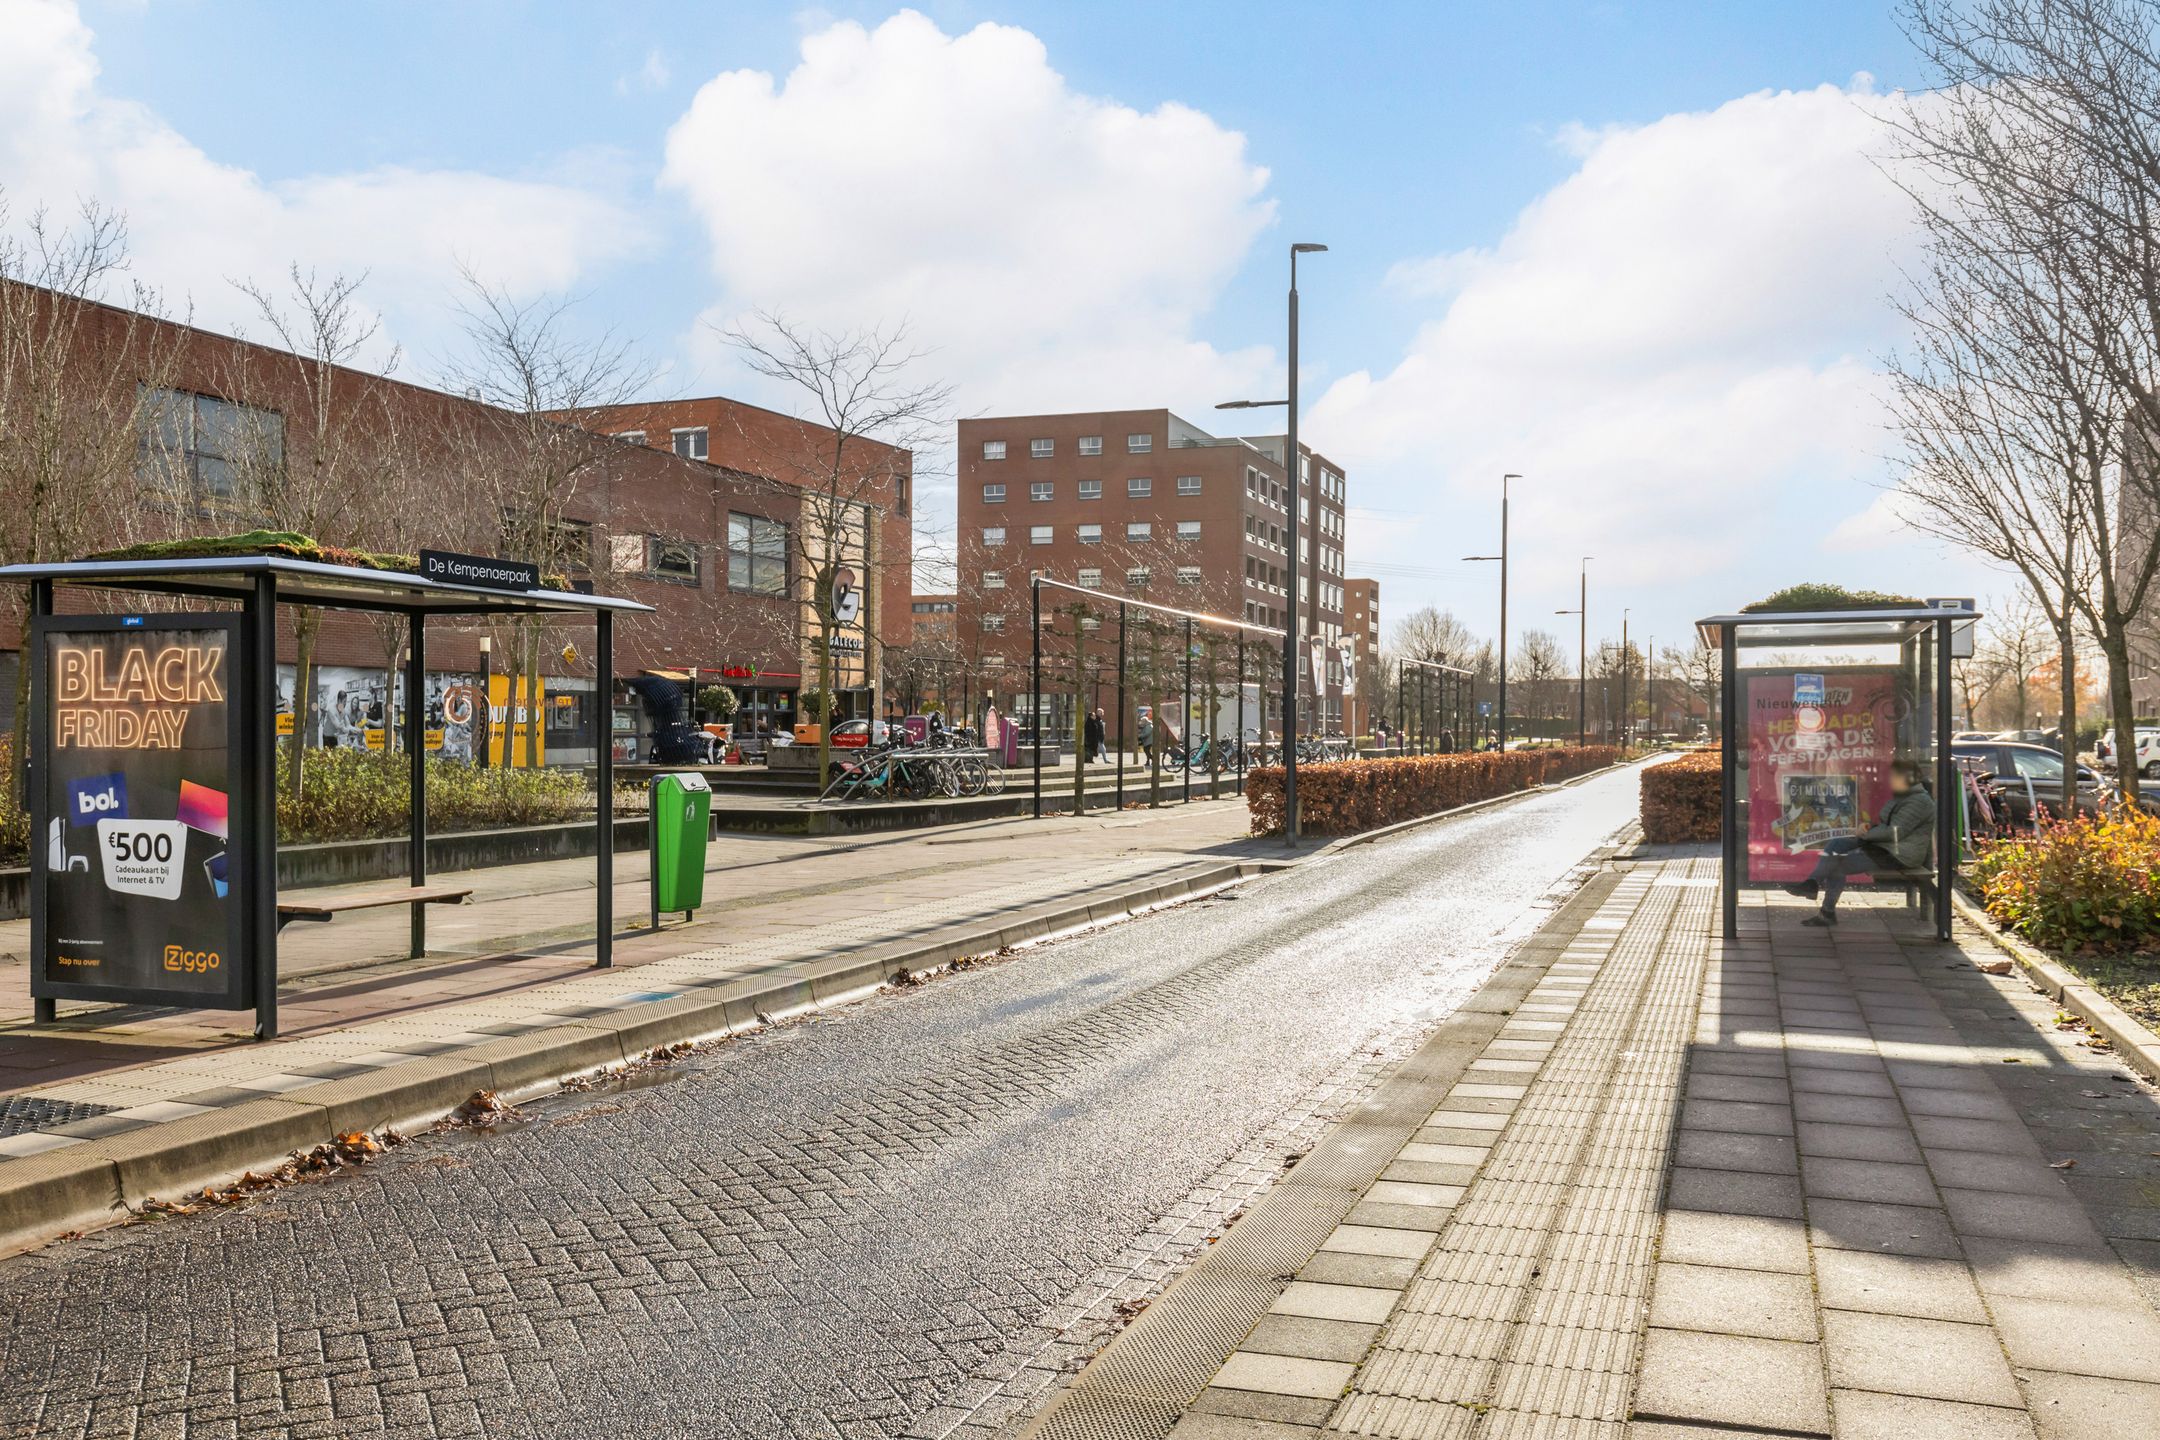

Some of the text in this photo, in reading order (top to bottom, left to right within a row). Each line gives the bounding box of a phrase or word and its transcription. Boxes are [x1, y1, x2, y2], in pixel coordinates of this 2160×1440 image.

[429, 557, 531, 584] De Kempenaerpark
[58, 647, 224, 702] BLACK
[57, 709, 189, 748] FRIDAY
[1768, 715, 1795, 735] HÉ
[1768, 747, 1874, 765] FEESTDAGEN
[78, 787, 119, 814] bol.
[1805, 784, 1850, 796] MILJOEN
[108, 832, 172, 862] €500
[115, 865, 170, 876] Cadeaukaart bij
[117, 876, 147, 884] Internet
[58, 956, 72, 967] Stap
[82, 959, 101, 967] over
[164, 945, 220, 973] Ziggo
